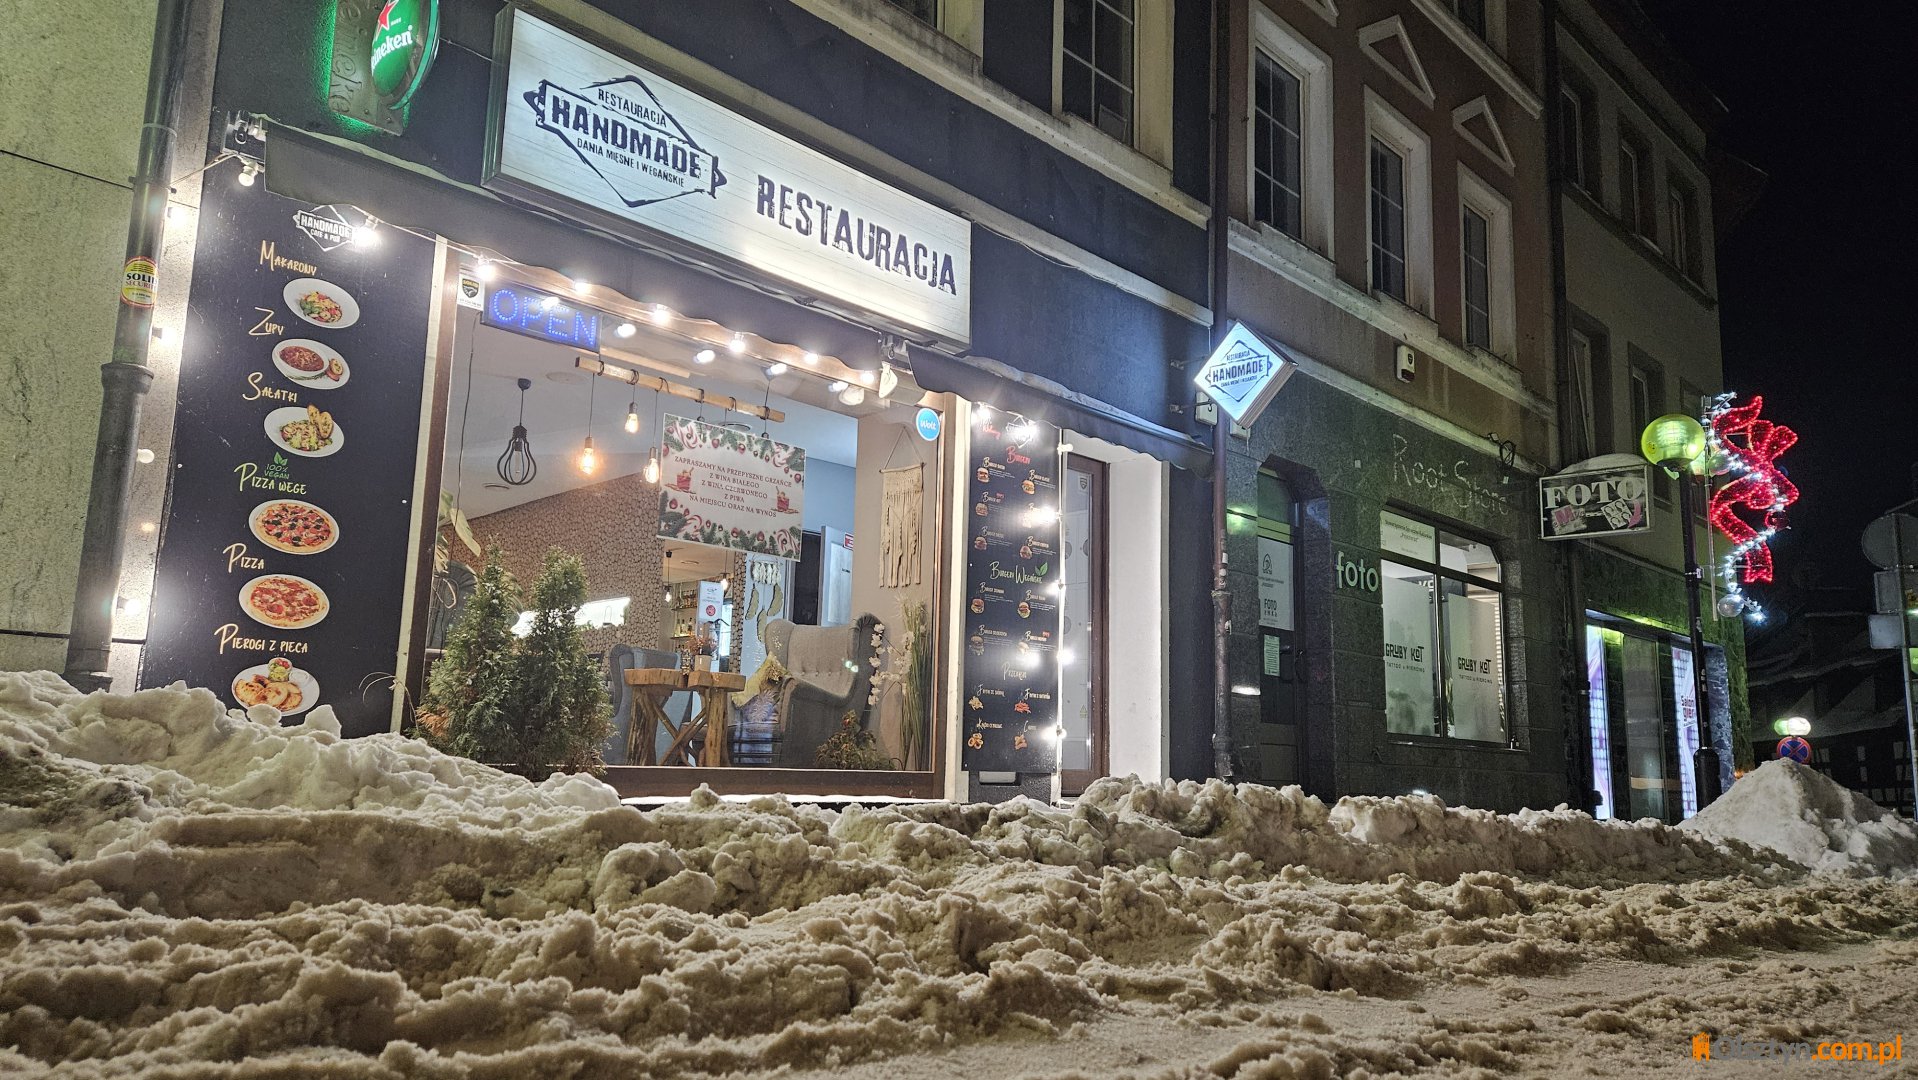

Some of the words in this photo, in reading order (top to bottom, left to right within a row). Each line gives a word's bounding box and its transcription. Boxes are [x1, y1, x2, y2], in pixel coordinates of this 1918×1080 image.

[371, 30, 413, 76] eineken
[598, 88, 667, 128] RESTAURACJA
[551, 95, 701, 178] HANDMADE
[577, 138, 603, 156] DANIA
[301, 214, 353, 239] HANDMADE
[756, 174, 957, 296] RESTAURACJA
[259, 239, 317, 276] MAKARONY
[248, 306, 284, 336] ZUPY
[493, 288, 597, 345] OPEN
[1212, 359, 1264, 383] HANDMADE
[233, 462, 275, 492] PIZZA
[278, 481, 307, 495] WEGE
[264, 471, 290, 480] VEGAN
[266, 463, 288, 472] 100%
[675, 456, 716, 470] ZAPRASZAMY
[727, 468, 763, 481] PRZEPYSZNE
[715, 474, 731, 483] WINA
[725, 485, 768, 499] CZERWONEGO
[730, 495, 745, 503] PIWA
[1543, 477, 1643, 509] FOTO
[700, 497, 727, 508] MIEJSCU
[728, 503, 745, 511] ORAZ
[756, 508, 777, 517] WYNOS
[222, 542, 265, 573] PIZZA
[1336, 551, 1379, 592] foto
[213, 623, 266, 655] PIEROGI
[268, 640, 277, 651] Z
[280, 641, 309, 654] PIECA
[1386, 643, 1407, 660] GRUBY
[1411, 645, 1424, 663] KOT
[1458, 657, 1477, 673] GRUBY
[1479, 659, 1491, 675] KOT
